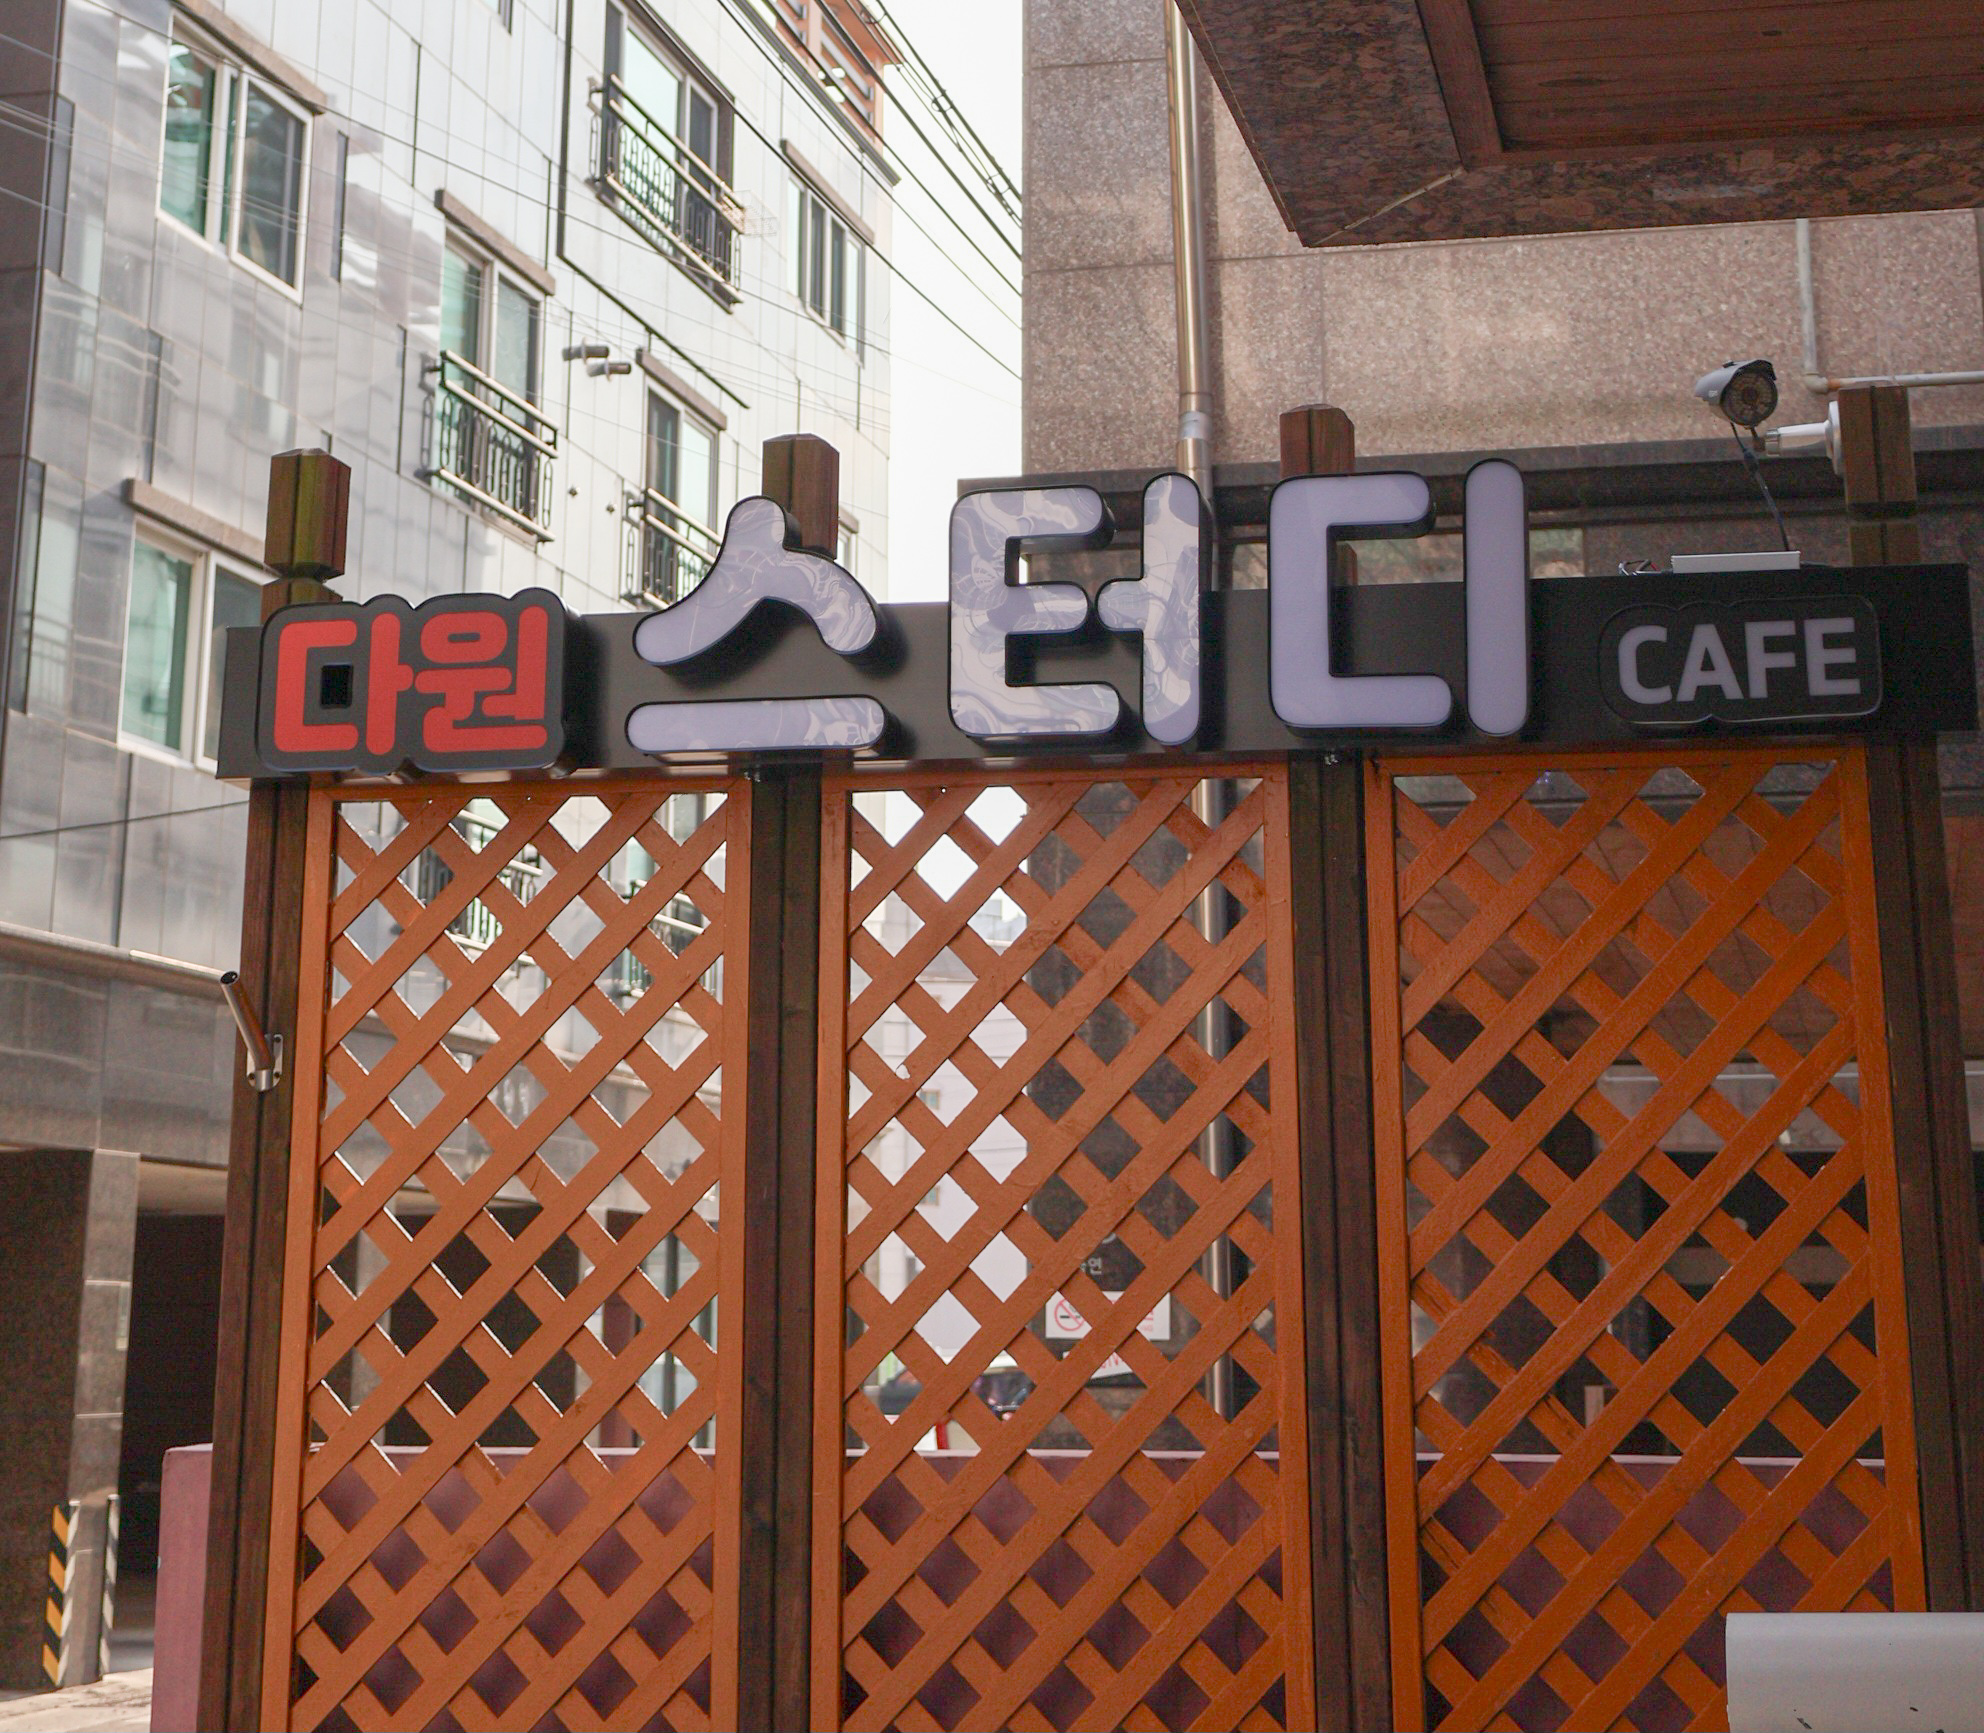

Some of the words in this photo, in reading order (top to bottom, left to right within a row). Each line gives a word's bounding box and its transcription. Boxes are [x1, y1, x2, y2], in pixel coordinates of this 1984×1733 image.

[273, 605, 548, 755] 다원
[626, 460, 1528, 752] 스터디
[1617, 616, 1862, 705] CAFE
